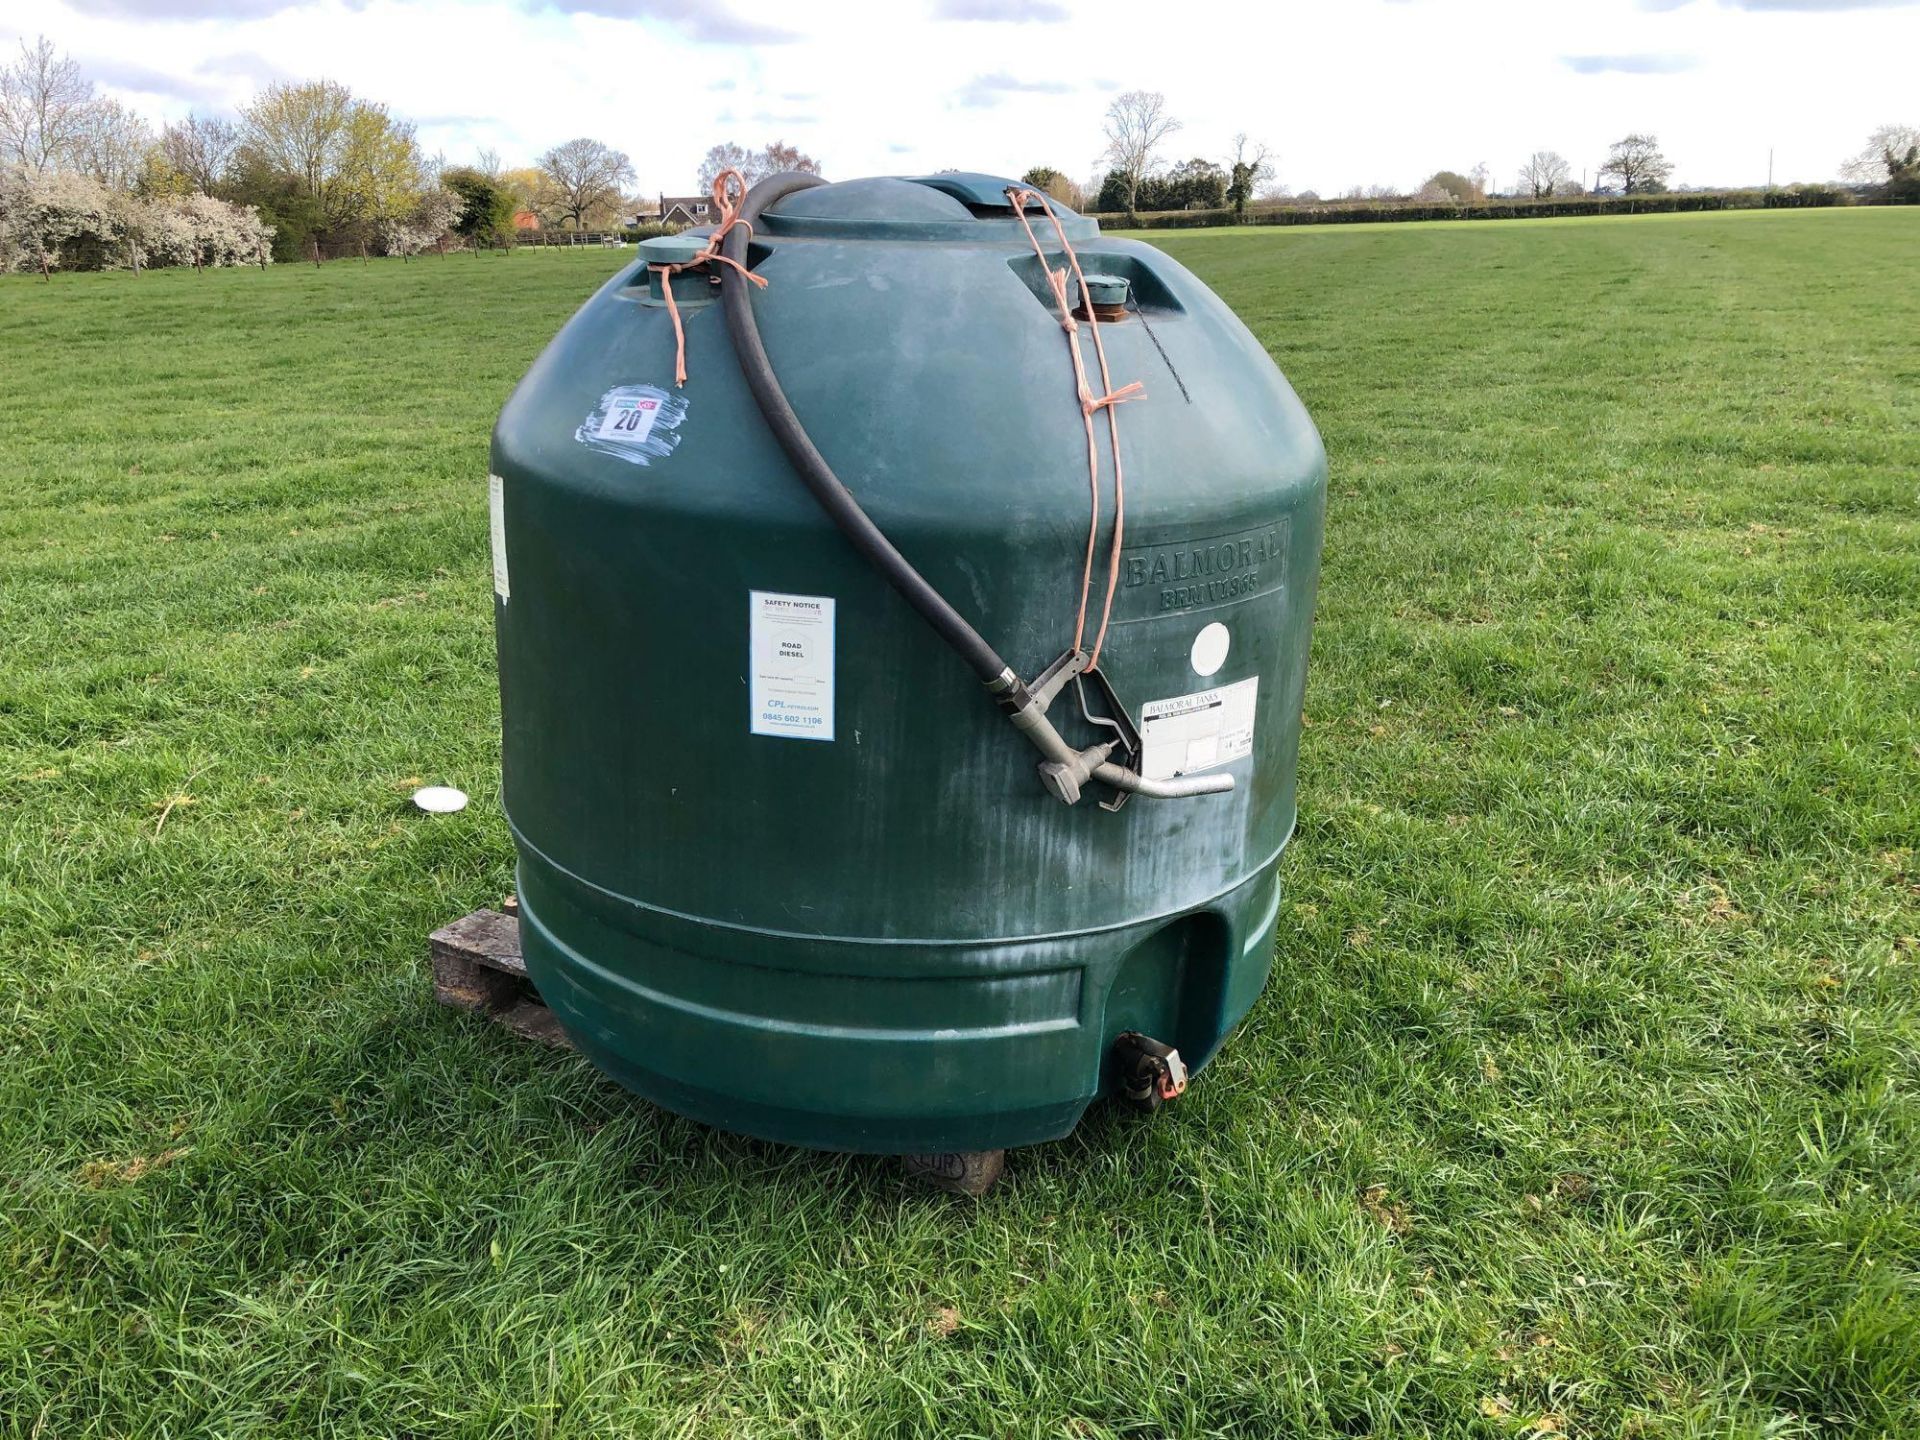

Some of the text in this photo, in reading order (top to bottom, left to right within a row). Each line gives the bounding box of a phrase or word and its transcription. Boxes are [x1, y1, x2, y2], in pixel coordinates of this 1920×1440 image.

[614, 409, 642, 431] 20
[1126, 531, 1280, 588] BALMORAL
[765, 599, 821, 610] SAFETY NOTICE
[781, 642, 802, 650] ROAD
[779, 650, 804, 658] DIESEL
[767, 699, 786, 709] CPL
[1149, 698, 1192, 715] BALMORAL
[1196, 693, 1219, 706] TANKS
[762, 713, 782, 722] 0845
[784, 714, 799, 723] 602
[802, 716, 823, 725] 1106
